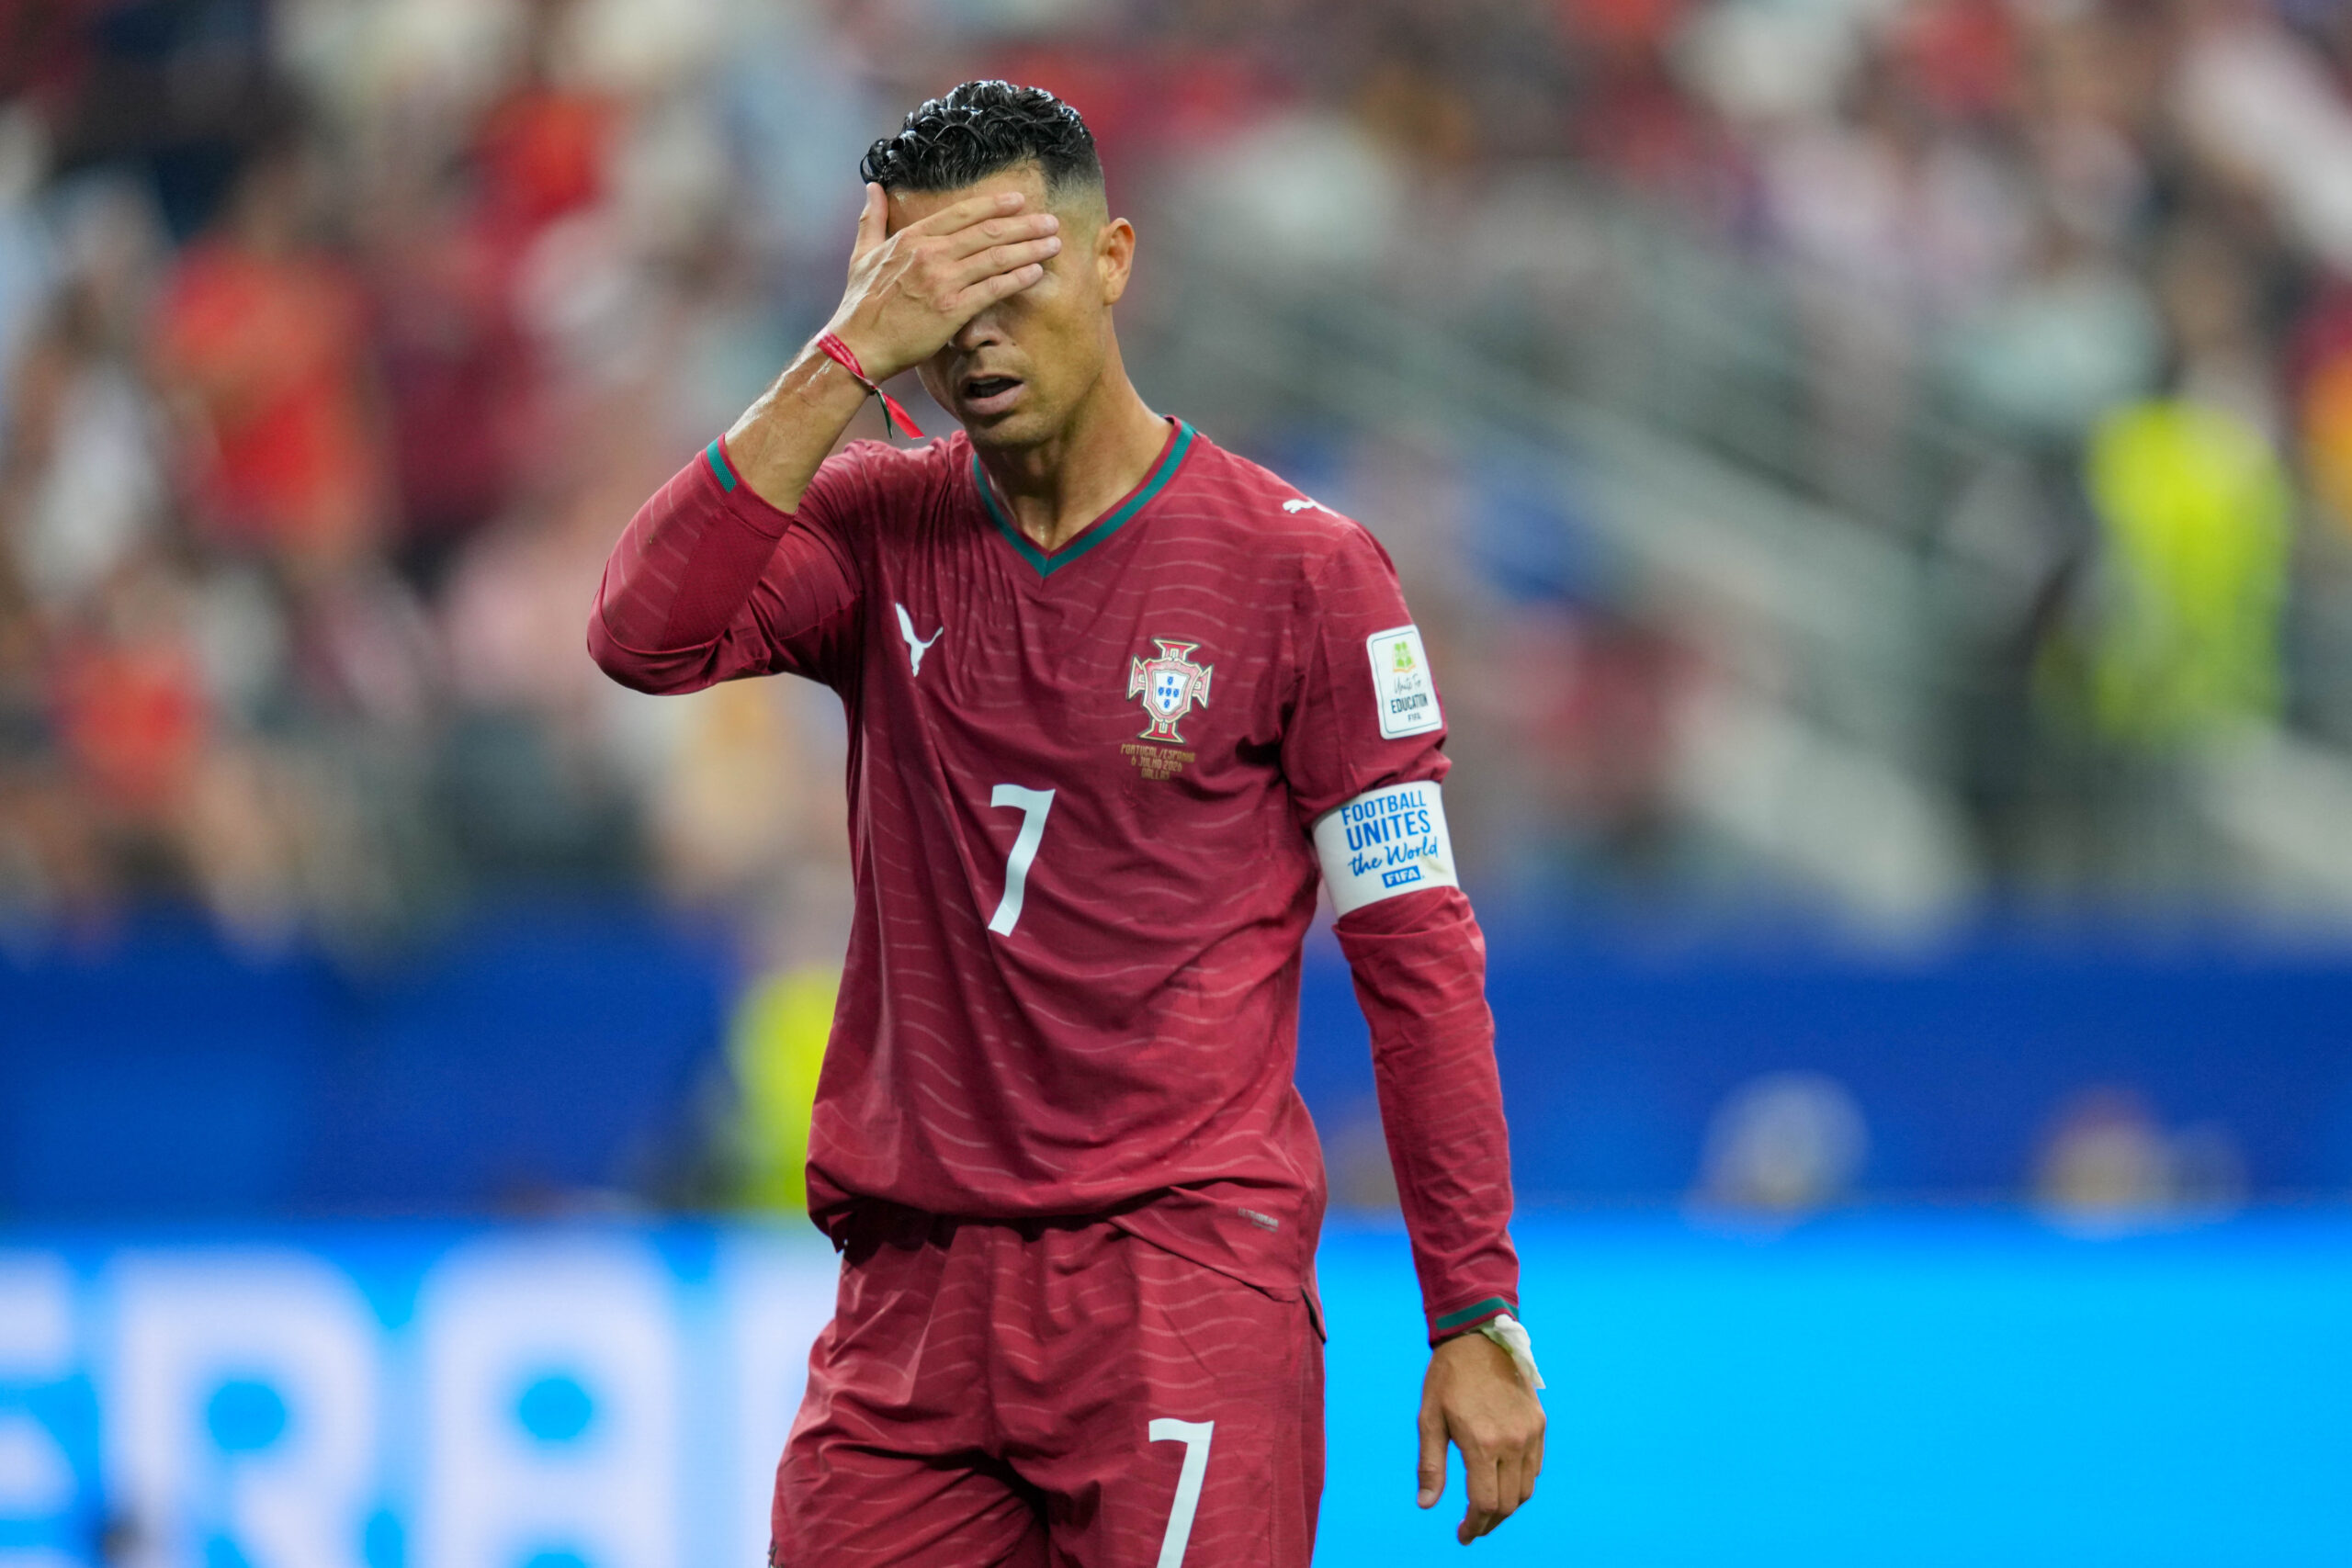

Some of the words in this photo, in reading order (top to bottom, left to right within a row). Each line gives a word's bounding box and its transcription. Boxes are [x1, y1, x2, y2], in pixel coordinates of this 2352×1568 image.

[1391, 693, 1429, 714] EDUCATION
[1340, 789, 1427, 826] FOOTBALL
[1345, 809, 1431, 852] UNITES
[988, 784, 1056, 937] 7
[1348, 852, 1383, 877] the
[1385, 835, 1439, 866] World
[1385, 868, 1420, 886] FIFA
[1148, 1417, 1215, 1568] 7
